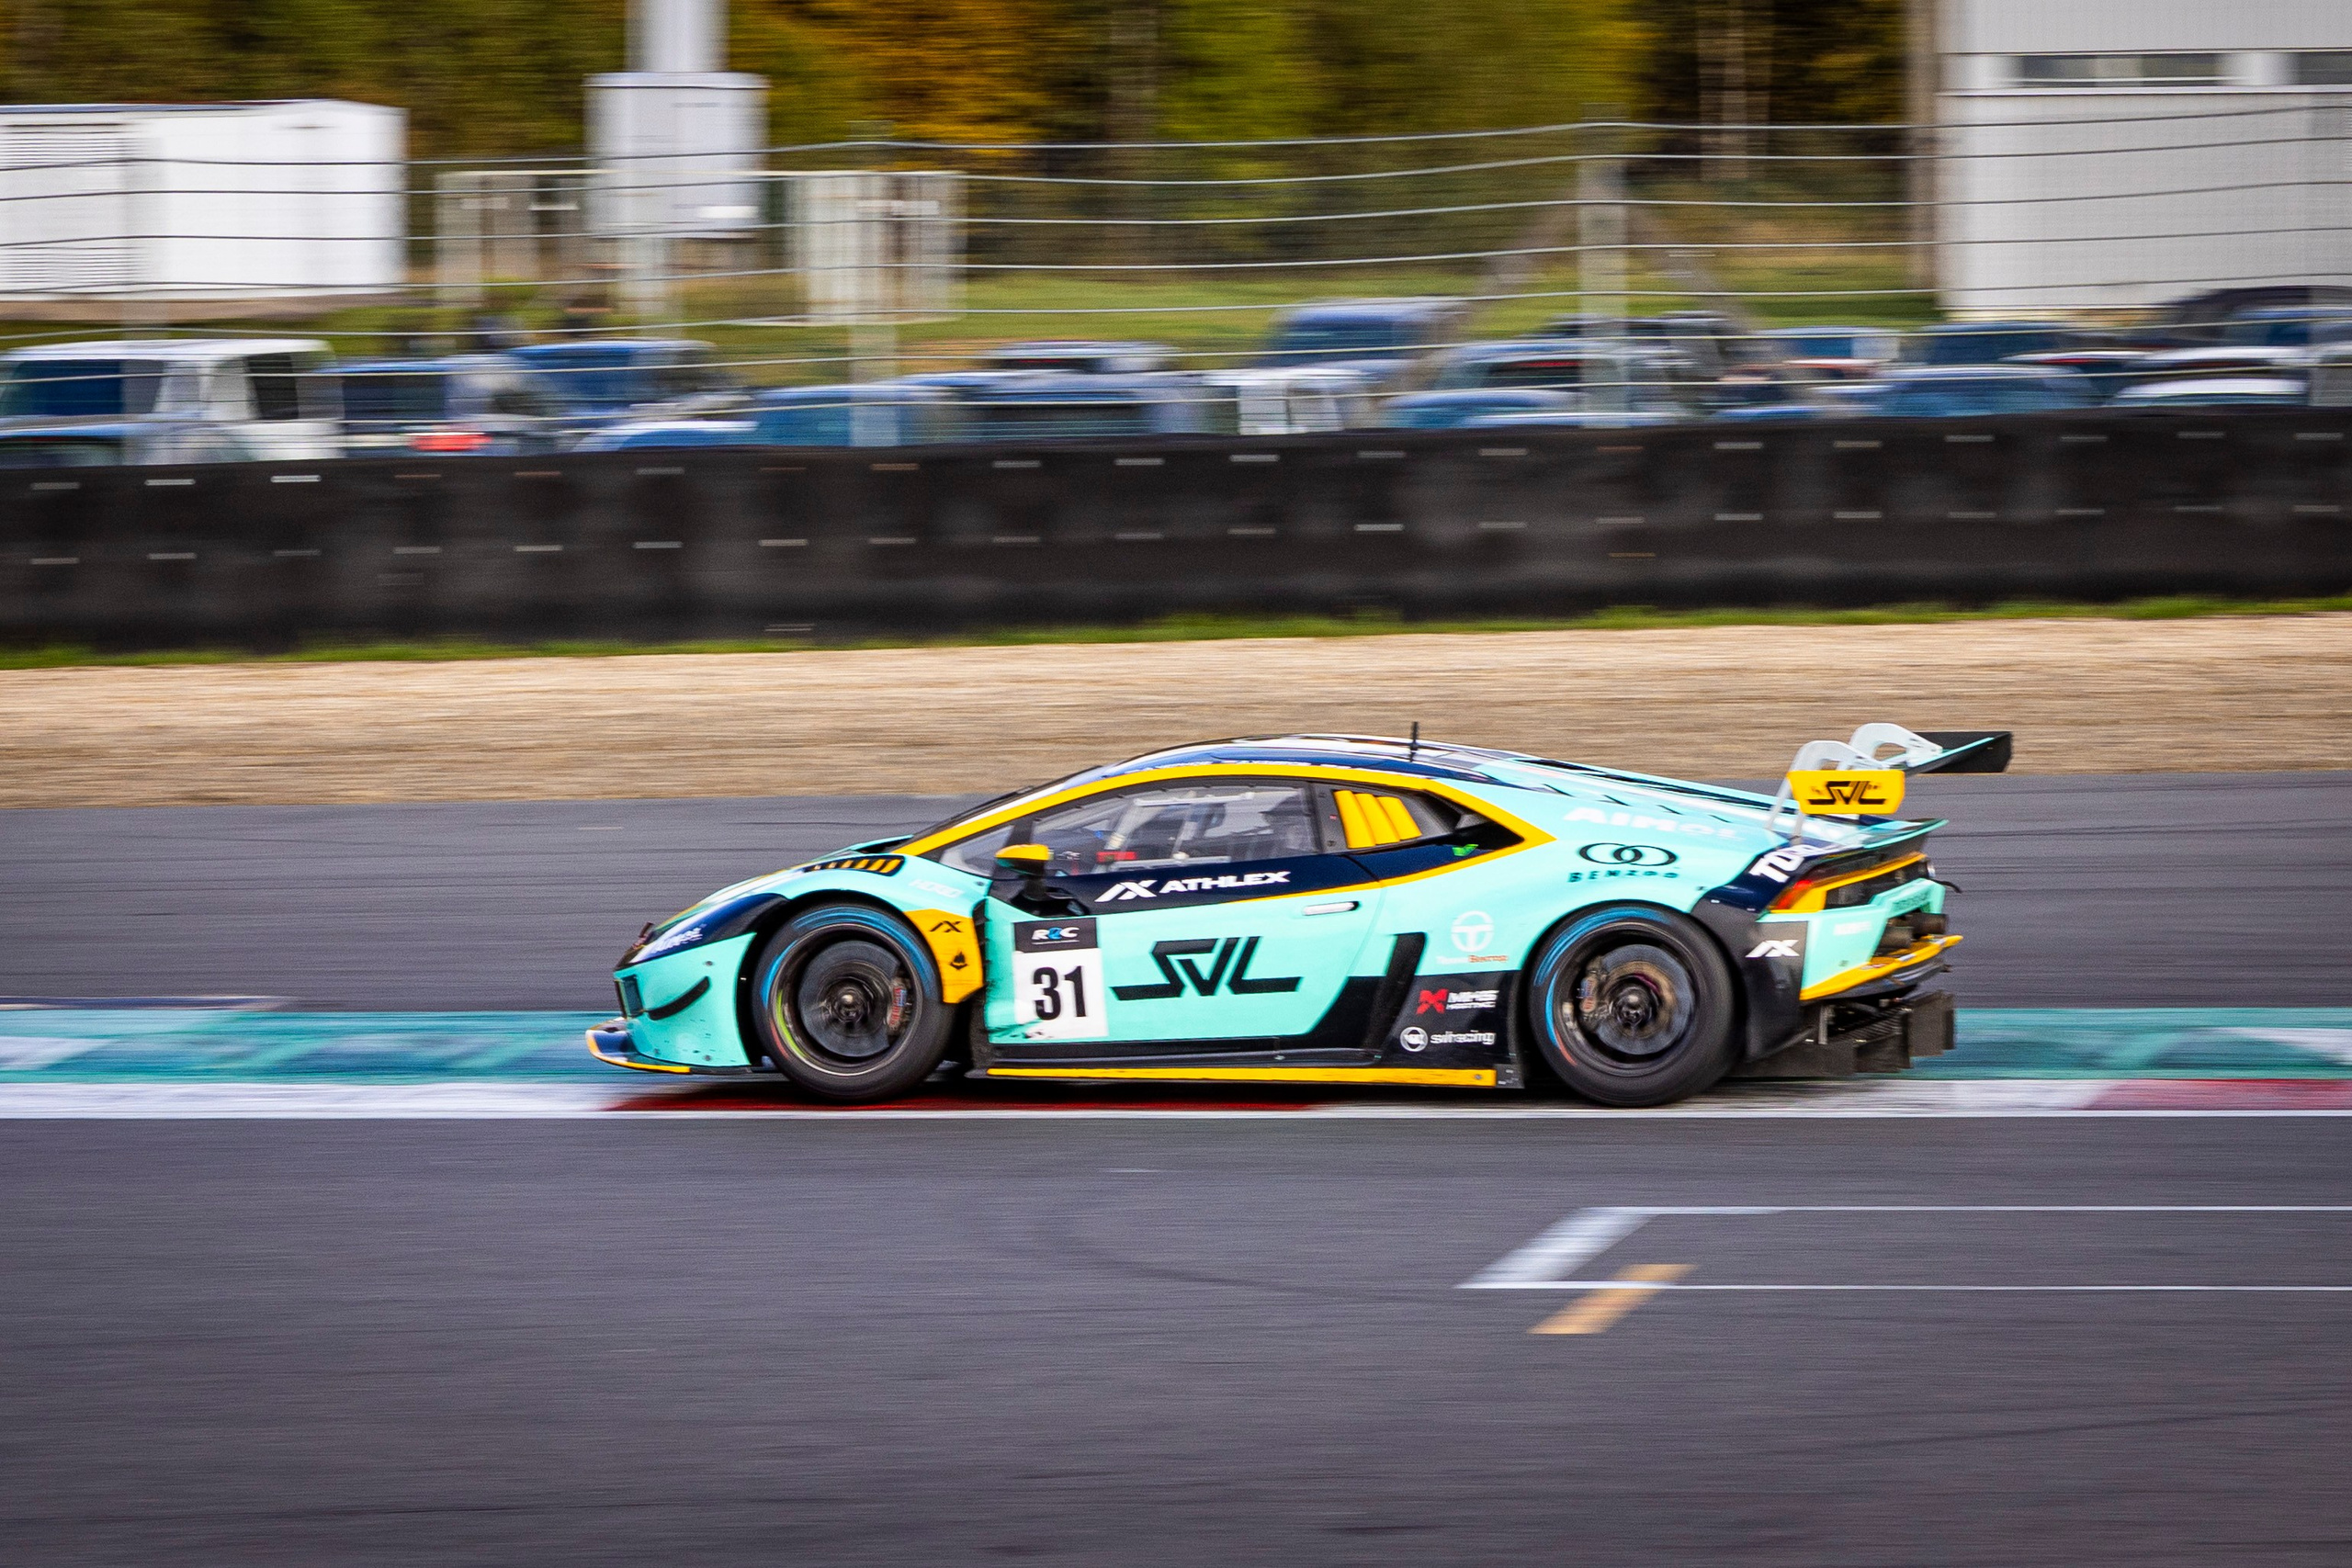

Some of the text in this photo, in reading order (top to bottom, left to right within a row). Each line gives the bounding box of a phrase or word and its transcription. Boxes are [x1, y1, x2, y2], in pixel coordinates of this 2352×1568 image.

[1159, 871, 1291, 893] ATHLEX
[1033, 965, 1087, 1021] 31
[1108, 936, 1303, 1000] SVL
